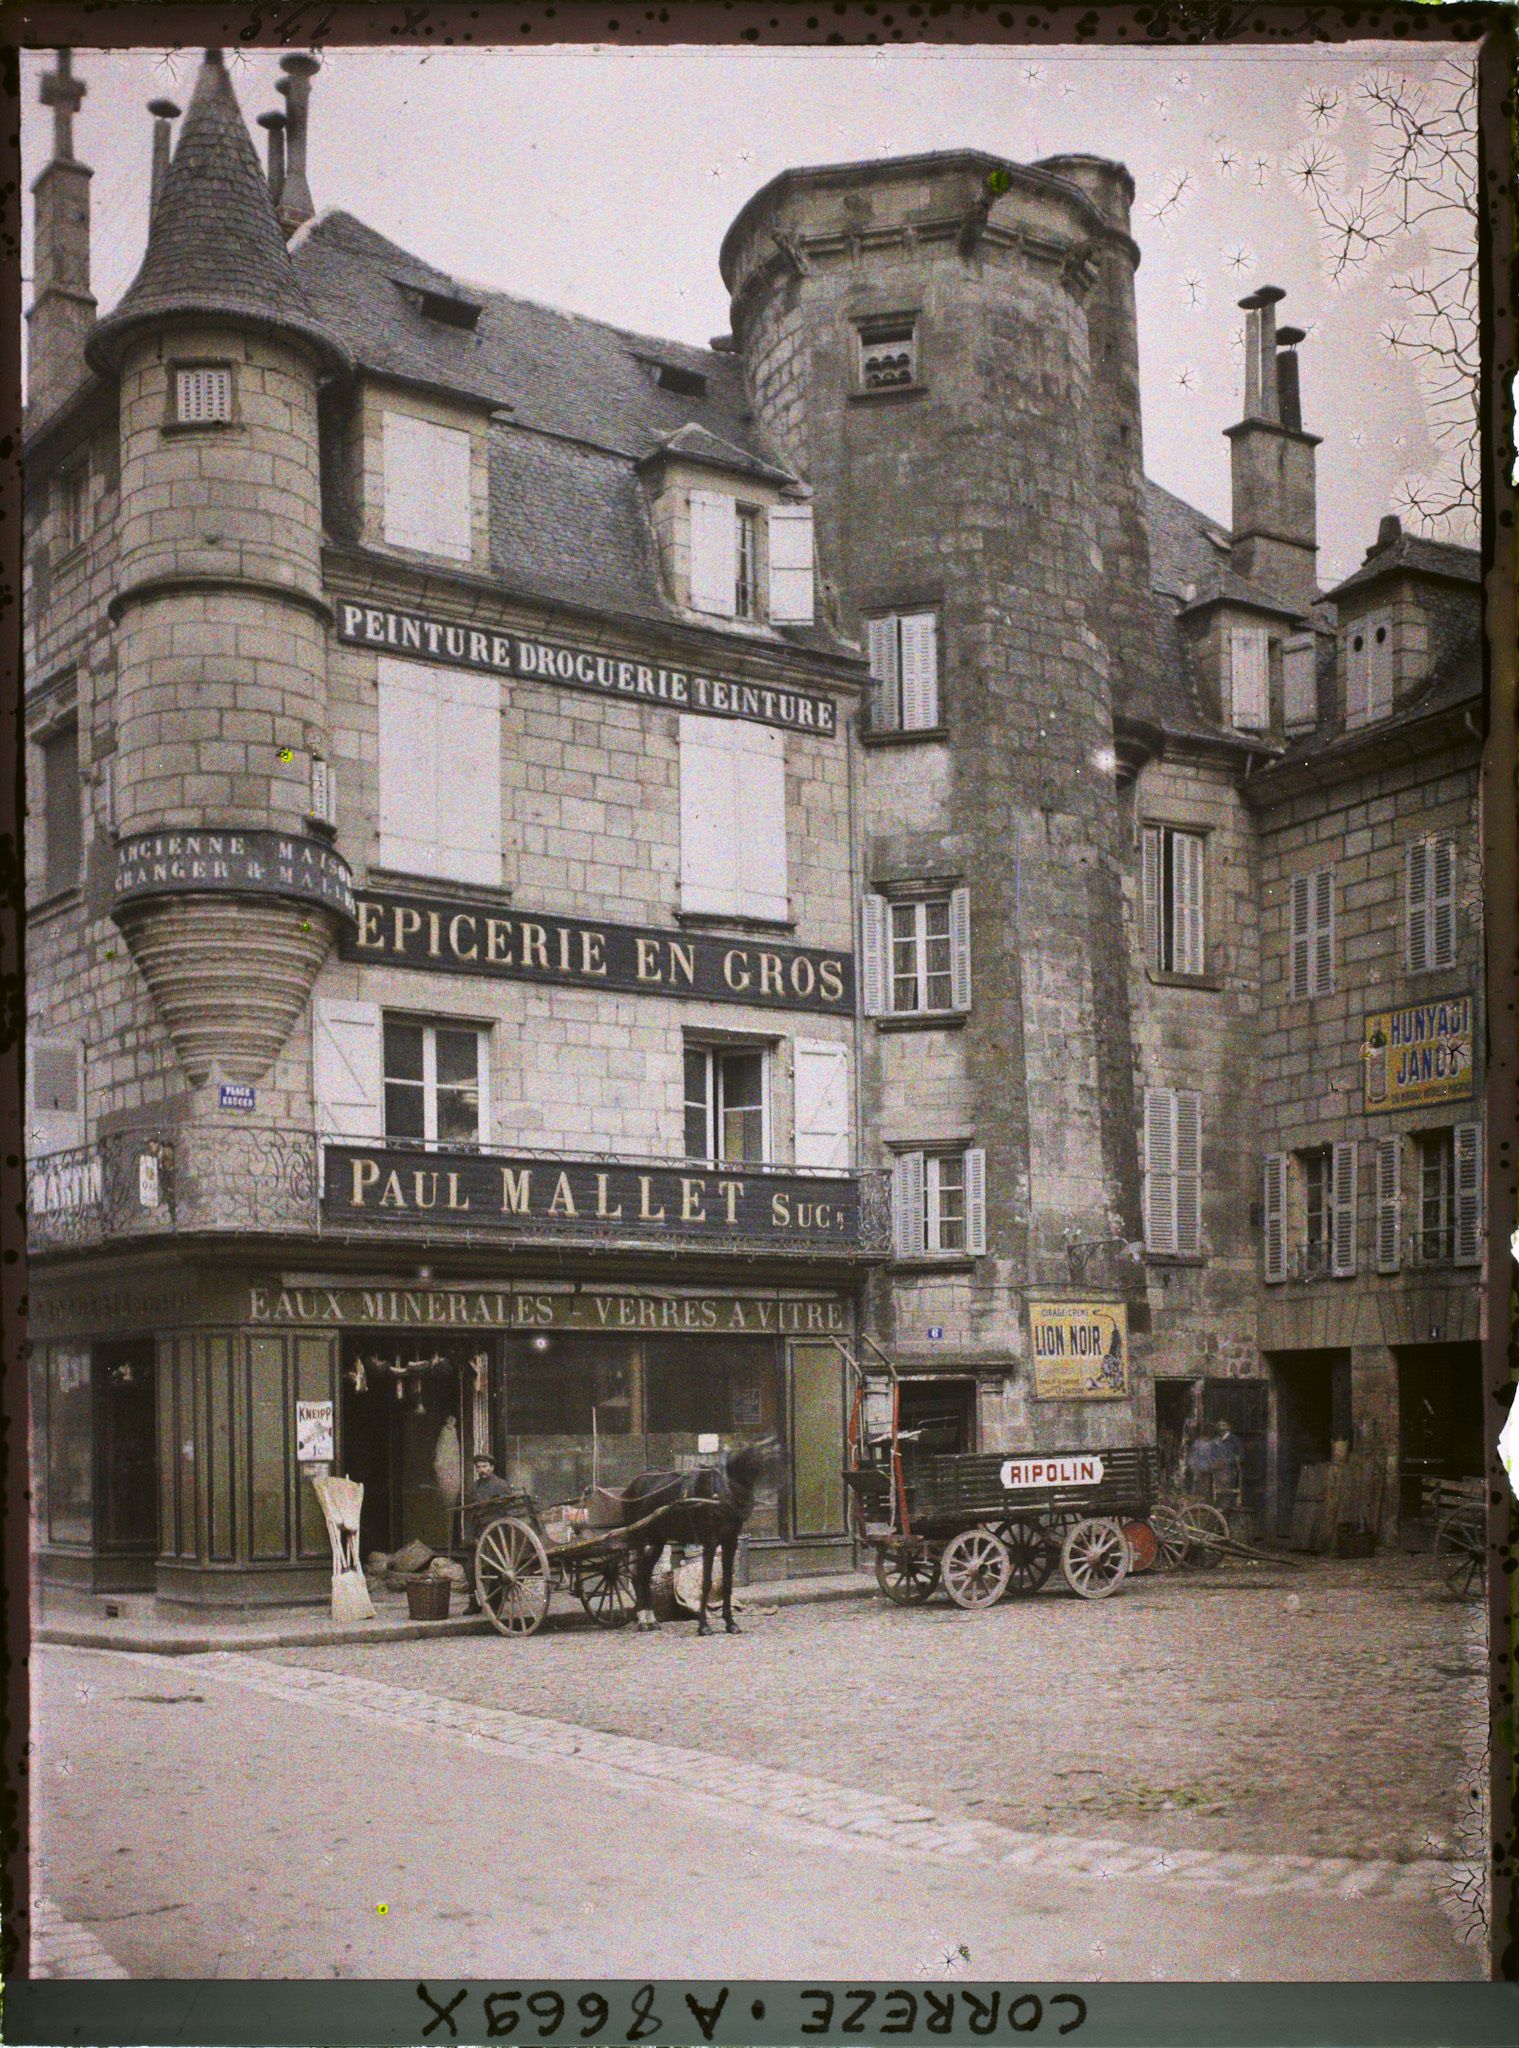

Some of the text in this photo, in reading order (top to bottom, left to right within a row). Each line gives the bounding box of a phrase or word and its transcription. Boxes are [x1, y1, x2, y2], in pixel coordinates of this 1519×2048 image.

[343, 604, 834, 730] PEINTURE DROGUERIE TEINTURE
[118, 836, 245, 866] ANCIENNE
[355, 900, 845, 1001] EPICERIE EN GROS
[1390, 998, 1470, 1046] HUNYADI
[348, 1158, 471, 1212] PAUL
[500, 1167, 746, 1225] MALLET
[250, 1287, 345, 1321] EAUX
[361, 1291, 554, 1325] MINERALES
[595, 1297, 718, 1328] VERRES
[729, 1300, 747, 1328] A
[757, 1301, 844, 1331] VITRE
[931, 1328, 939, 1338] 6
[1034, 1325, 1102, 1357] LION NOIR
[298, 1405, 332, 1423] KNEIPP
[1010, 1461, 1095, 1484] RIPOLIN
